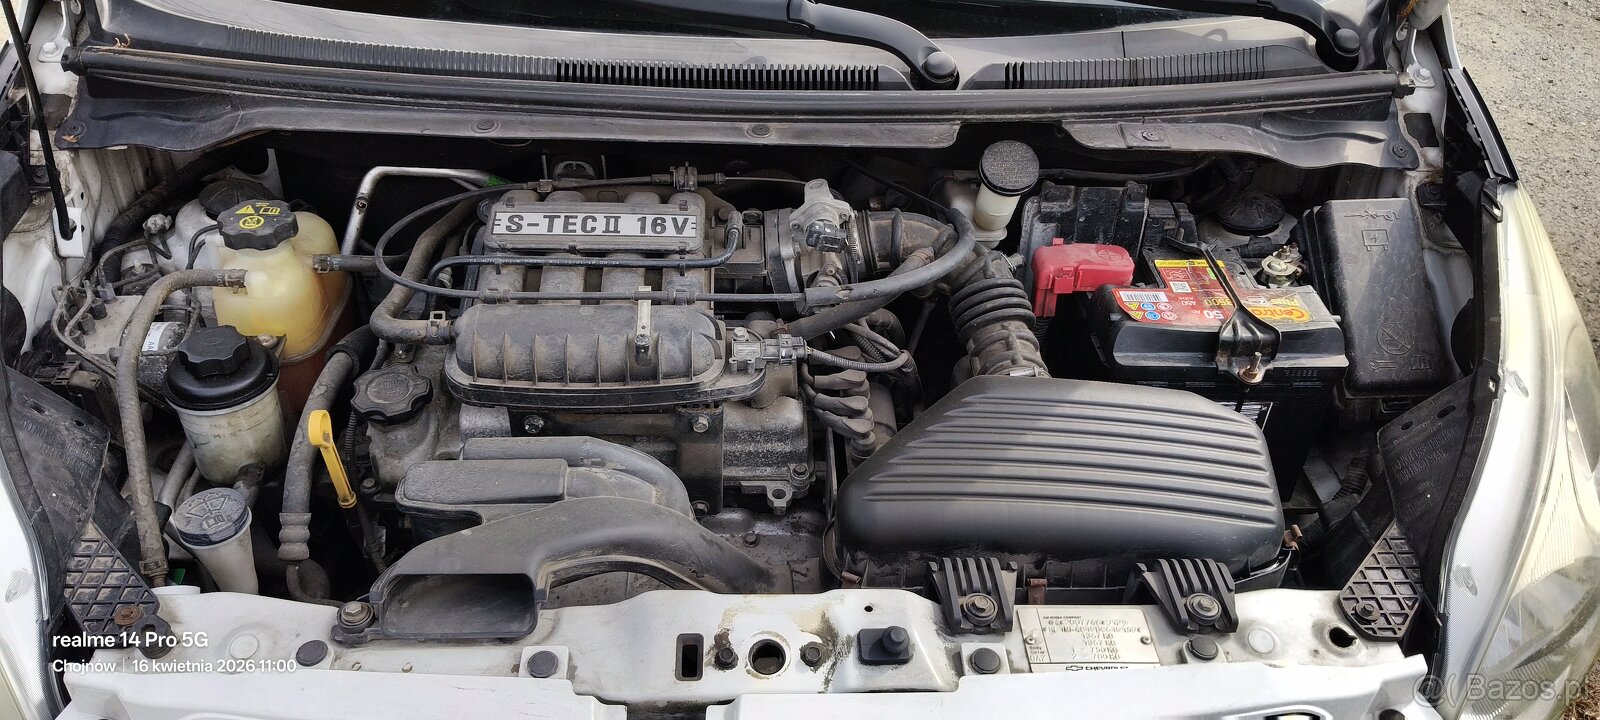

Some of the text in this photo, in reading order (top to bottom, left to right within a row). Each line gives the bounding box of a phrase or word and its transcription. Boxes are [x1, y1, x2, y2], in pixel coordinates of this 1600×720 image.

[636, 216, 690, 235] 16V
[1203, 310, 1225, 319] 50
[1250, 308, 1305, 319] Centra
